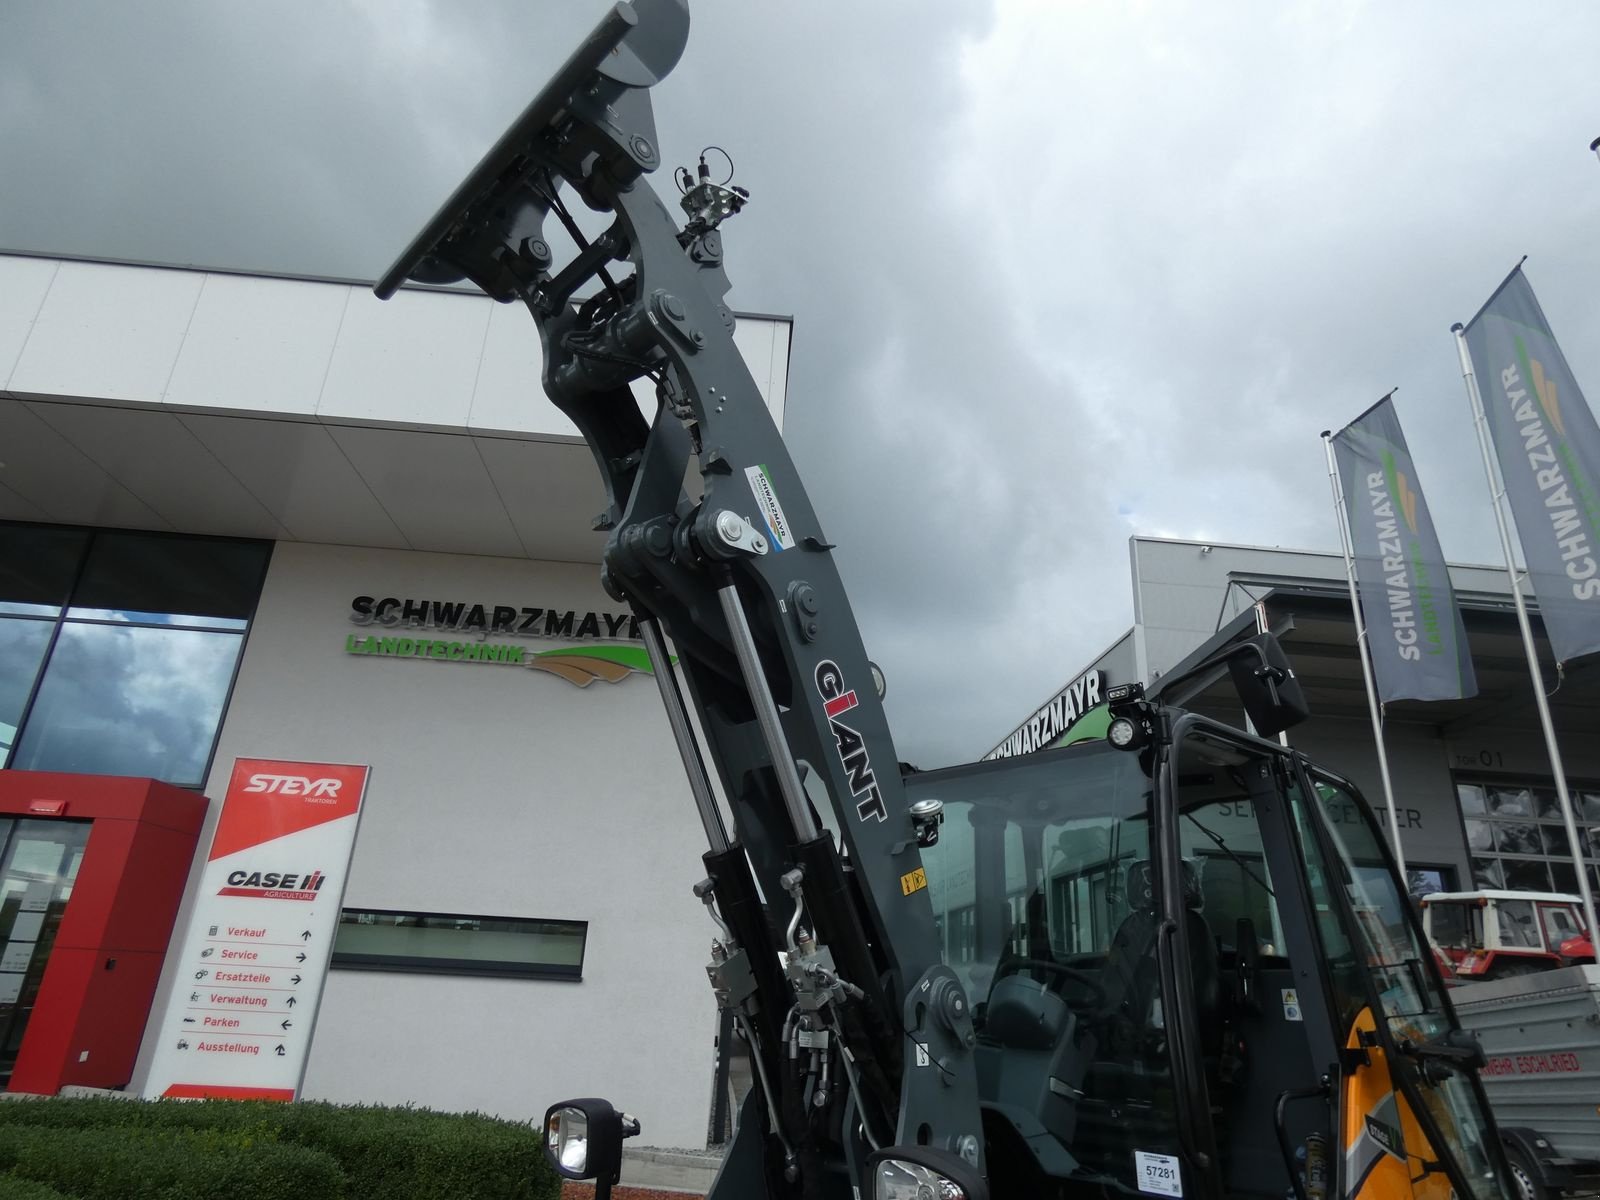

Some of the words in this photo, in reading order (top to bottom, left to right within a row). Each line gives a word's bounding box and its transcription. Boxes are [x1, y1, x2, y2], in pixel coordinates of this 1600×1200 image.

[1501, 362, 1600, 600] SCHWARZMAYR
[758, 472, 786, 537] SCHWARZMAYR
[1366, 470, 1421, 661] SCHWARZMAYR
[344, 634, 526, 664] LANDTECHNIK
[814, 659, 888, 823] GIANT
[243, 773, 342, 798] STEYR
[304, 797, 338, 805] TRAKTOREN
[227, 870, 299, 890] CASE
[263, 890, 315, 900] AGRICULTURE
[227, 926, 267, 938] Verkauf
[221, 949, 258, 961] Service
[215, 971, 271, 984] Ersatzteile
[210, 993, 268, 1008] Verwaltung
[203, 1016, 240, 1028] Parken
[197, 1041, 260, 1056] Ausstellung
[1516, 1053, 1582, 1075] ESCHLRIED
[1145, 1165, 1176, 1180] 57281
